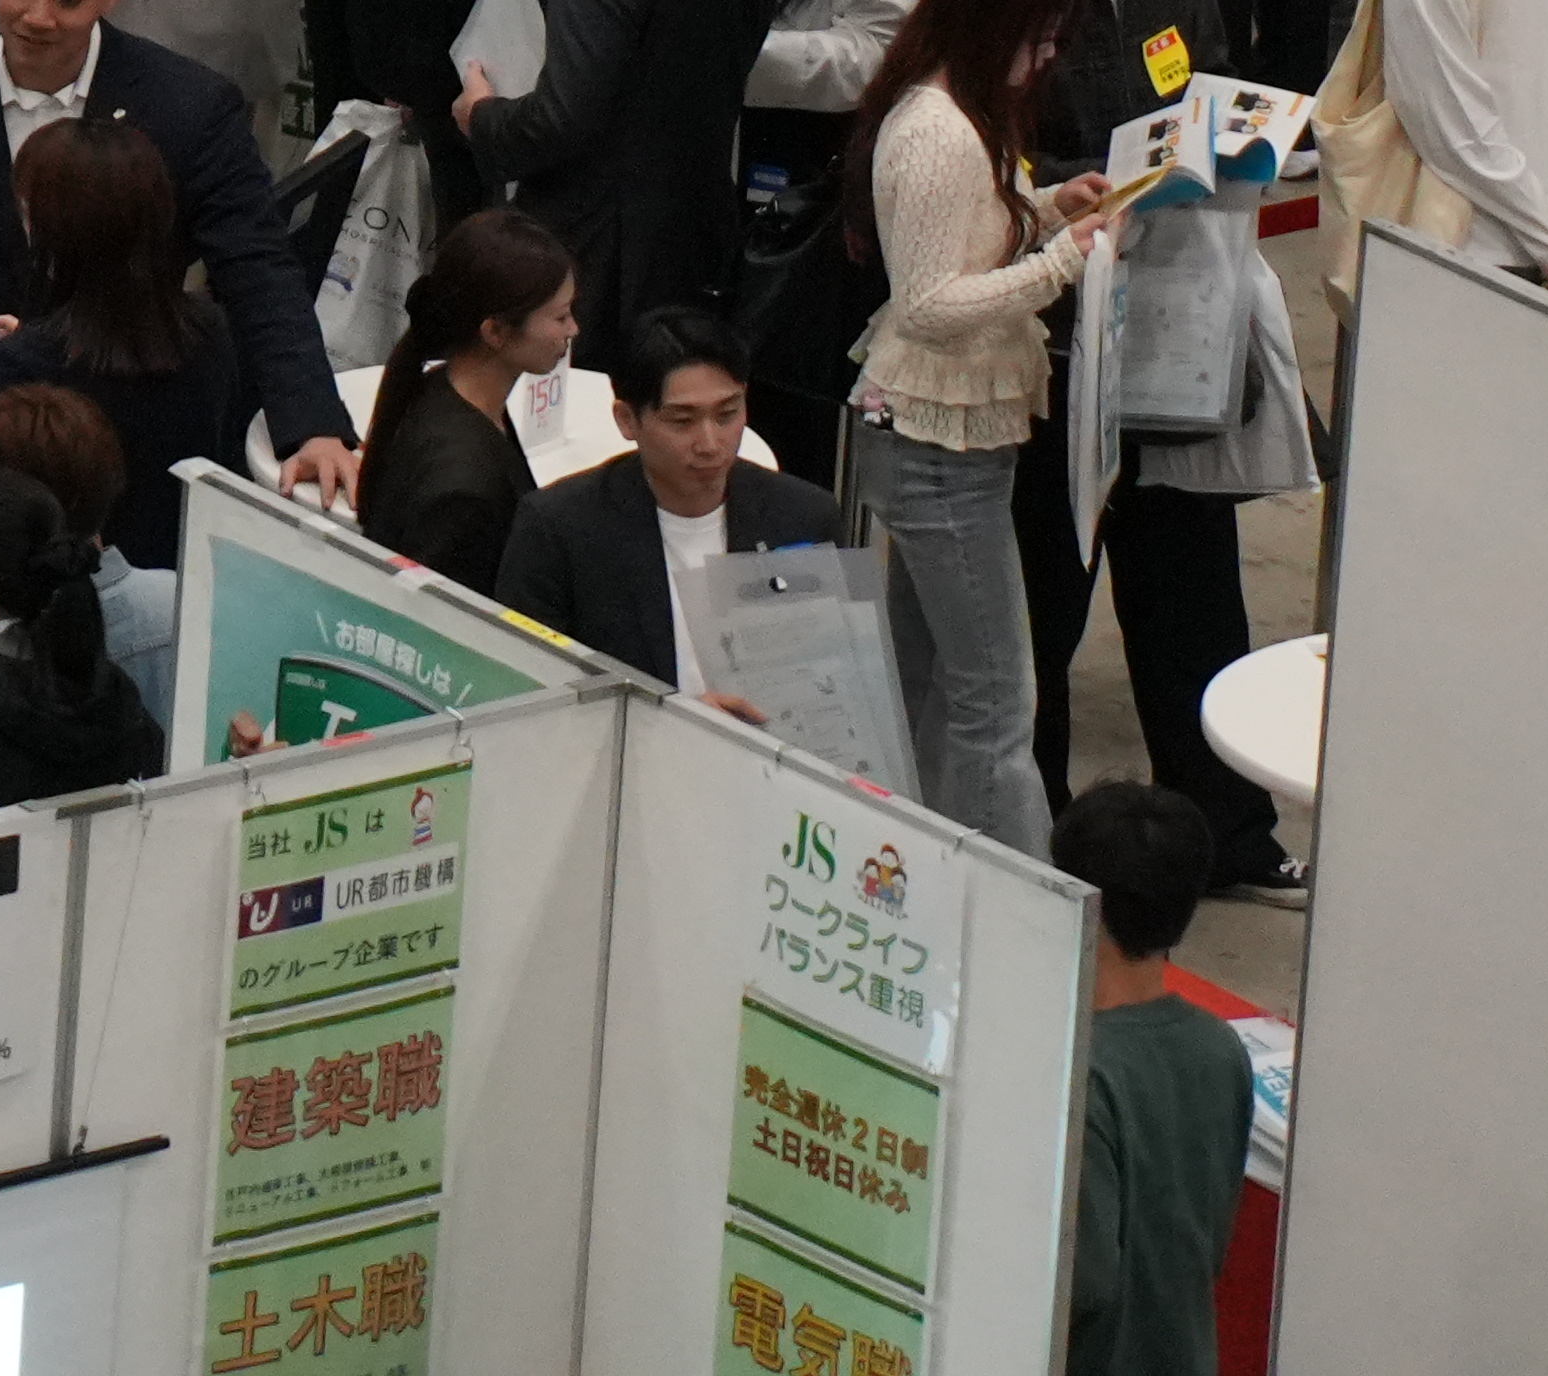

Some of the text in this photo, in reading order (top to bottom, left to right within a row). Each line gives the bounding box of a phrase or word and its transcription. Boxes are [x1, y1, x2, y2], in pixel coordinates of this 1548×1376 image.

[334, 619, 453, 696] お部屋探しは
[246, 808, 384, 862] 当社 JS は
[783, 810, 837, 885] JS
[335, 855, 456, 910] UR都市機構
[766, 870, 928, 976] ワークライフ
[237, 921, 445, 992] のグループ企業です
[761, 920, 926, 1029] バランス重視
[226, 1029, 444, 1156] 建築職
[752, 1114, 912, 1216] 土日祝日休み
[210, 1251, 428, 1375] 土木職
